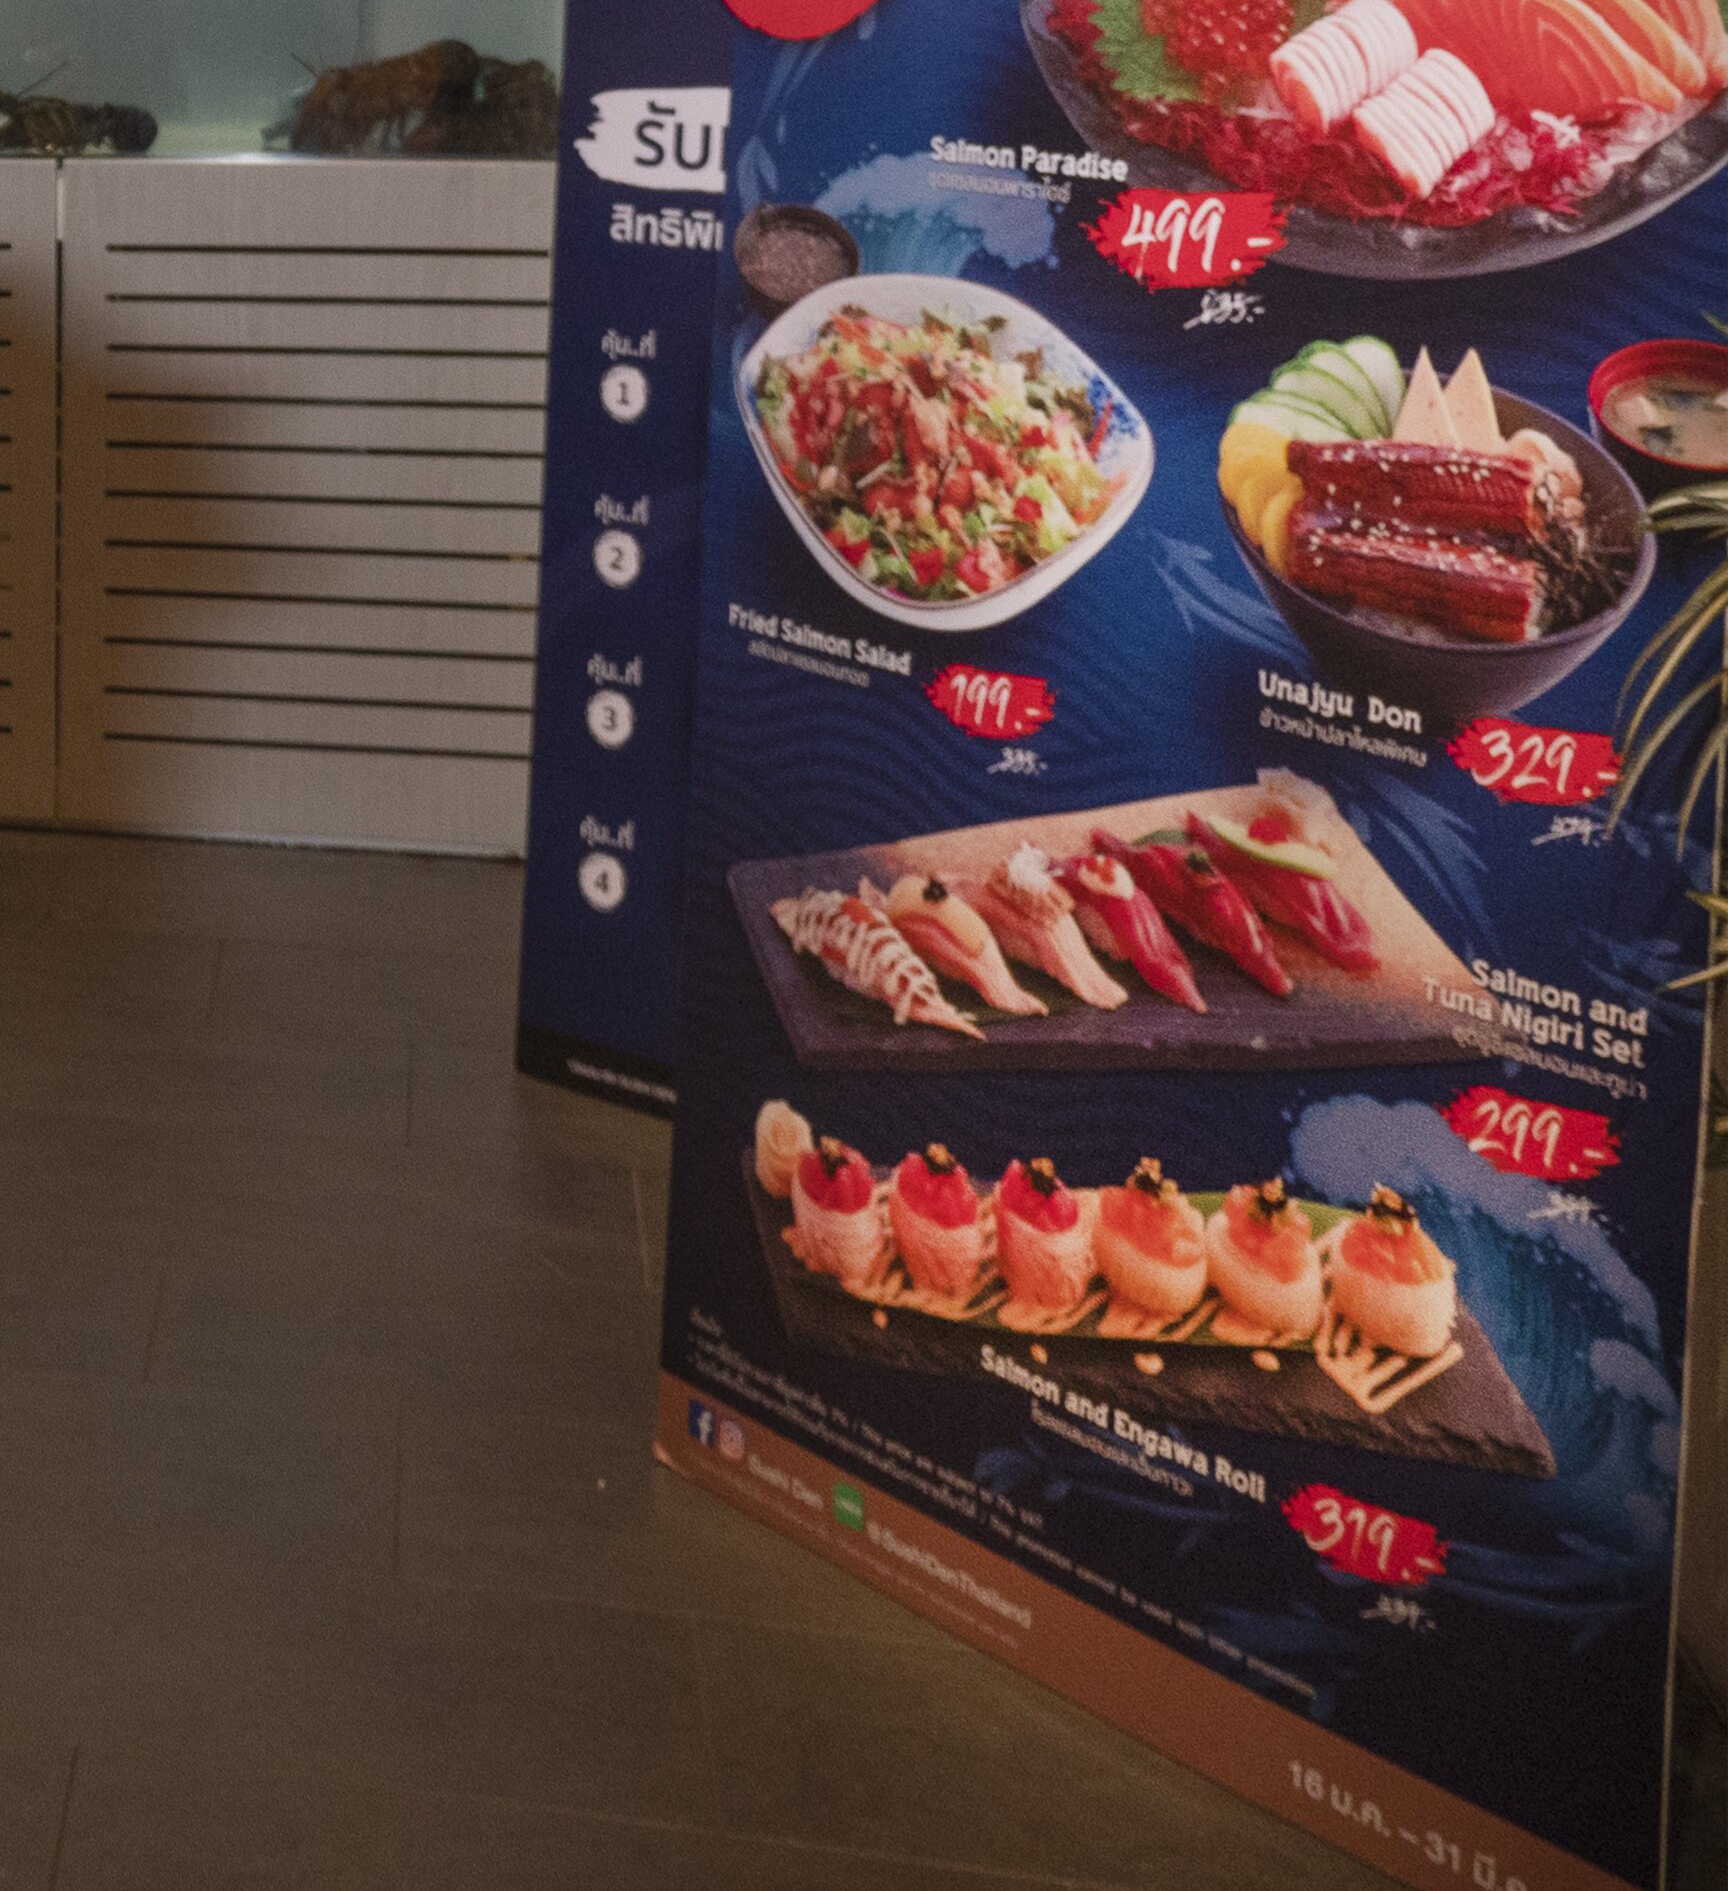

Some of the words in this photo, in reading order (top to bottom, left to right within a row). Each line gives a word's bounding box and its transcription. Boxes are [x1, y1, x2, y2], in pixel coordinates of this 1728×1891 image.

[930, 134, 1017, 170] Salmon
[1021, 144, 1129, 183] Paradise
[1121, 197, 1274, 280] 499.-
[728, 602, 780, 639] Fried
[780, 617, 854, 661] Salmon
[854, 637, 913, 677] Salad
[950, 672, 1042, 732] 199.-
[1258, 668, 1355, 719] Unajyu
[1367, 694, 1424, 735] Don
[1470, 727, 1619, 796] 329.-
[1420, 974, 1495, 1023] Tuna
[1500, 999, 1585, 1052] Nigiri
[1592, 1025, 1645, 1069] Set
[1471, 958, 1581, 1017] Salmon
[1589, 997, 1649, 1037] and
[1467, 1099, 1606, 1174] 299.-
[980, 1344, 1060, 1407] Salmon
[1063, 1389, 1110, 1431] and
[1112, 1405, 1211, 1479] Engawa
[1213, 1453, 1269, 1504] Roll
[1302, 1496, 1440, 1582] 319.-
[1289, 1759, 1325, 1801] 16
[1423, 1829, 1462, 1874] 31
